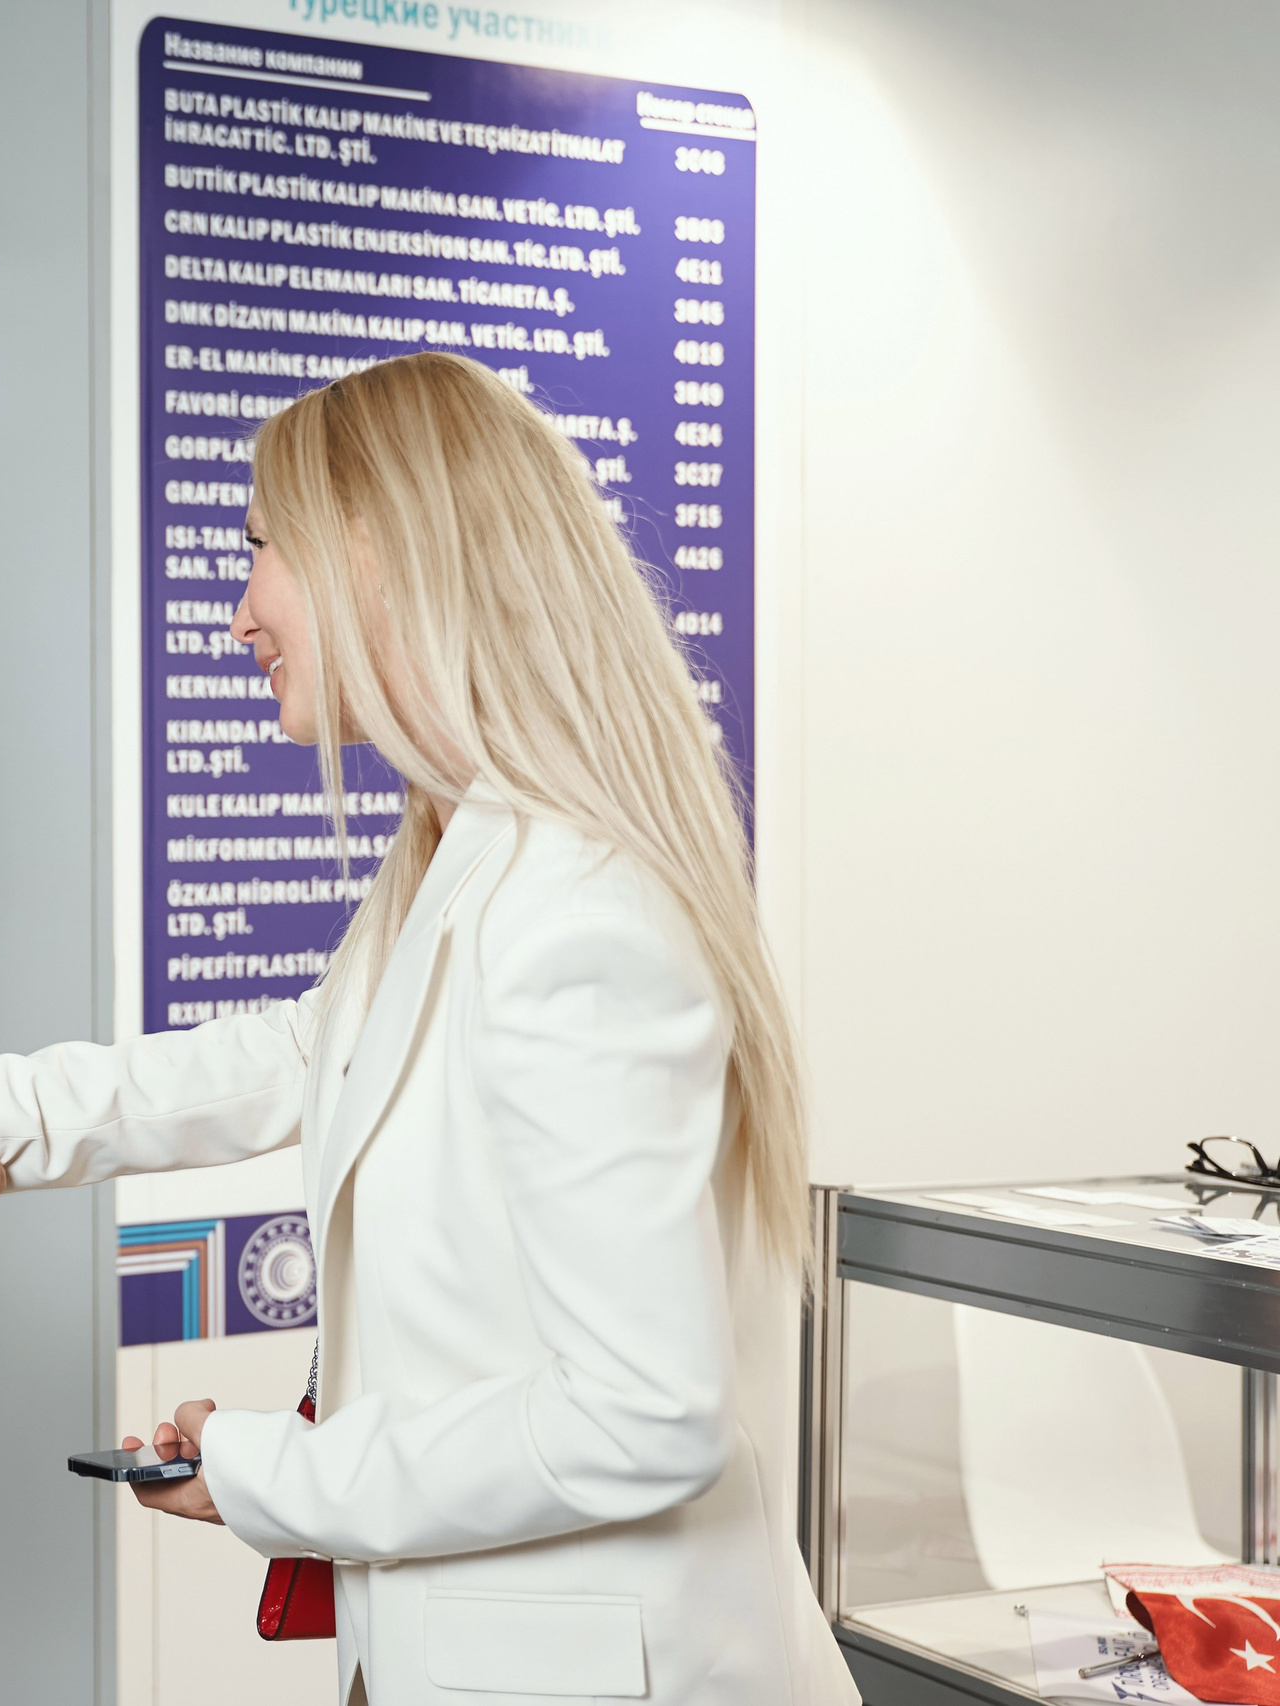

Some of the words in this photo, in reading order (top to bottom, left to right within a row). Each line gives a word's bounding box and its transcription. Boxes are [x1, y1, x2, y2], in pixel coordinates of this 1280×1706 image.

[164, 31, 263, 69] Название
[265, 48, 364, 81] компании
[164, 88, 219, 117] BUTA
[221, 94, 305, 125] PLASTİK
[305, 102, 363, 133] KALIP
[363, 111, 438, 143] MAKİNE
[295, 133, 337, 160] LTD.
[339, 136, 377, 167] ŞTİ.
[165, 164, 238, 194] BUTTİK
[238, 171, 321, 203] PLASTİK
[322, 180, 380, 208] KALIP
[380, 186, 457, 217] MAKİNA
[458, 194, 503, 222] SAN.
[164, 209, 209, 236] CRN
[210, 213, 270, 241] KALIP
[270, 219, 353, 249] PLASTİK
[353, 227, 469, 260] ENJEKSİYON
[469, 238, 514, 266] SAN.
[165, 254, 228, 283] DELTA
[228, 259, 288, 287] KALIP
[289, 265, 412, 299] ELEMANLARI
[412, 275, 459, 303] SAN.
[165, 300, 213, 326] DMK
[214, 301, 287, 332] DİZAYN
[289, 308, 367, 338] MAKİNA
[368, 316, 424, 342] KALIP
[425, 319, 471, 347] SAN.
[165, 345, 224, 372] ER-EL
[225, 348, 305, 378] MAKİNE
[165, 388, 239, 417] FAVORİ
[674, 421, 723, 447] 4E34
[674, 461, 723, 487] 3C37
[165, 480, 247, 506] GRAFEN
[675, 503, 723, 528] 3F15
[165, 555, 216, 580] SAN.
[674, 546, 723, 570] 4A26
[165, 600, 234, 625] KEMAL
[675, 612, 723, 636] 4D14
[166, 674, 247, 699] KERVAN
[166, 720, 259, 744] KIRANDA
[167, 793, 221, 818] KULE
[221, 793, 282, 817] KALIP
[167, 834, 293, 862] MİKFORMEN
[167, 879, 236, 907] ÖZKAR
[236, 876, 334, 904] HİDROLİK
[168, 952, 246, 981] PİPEFİT
